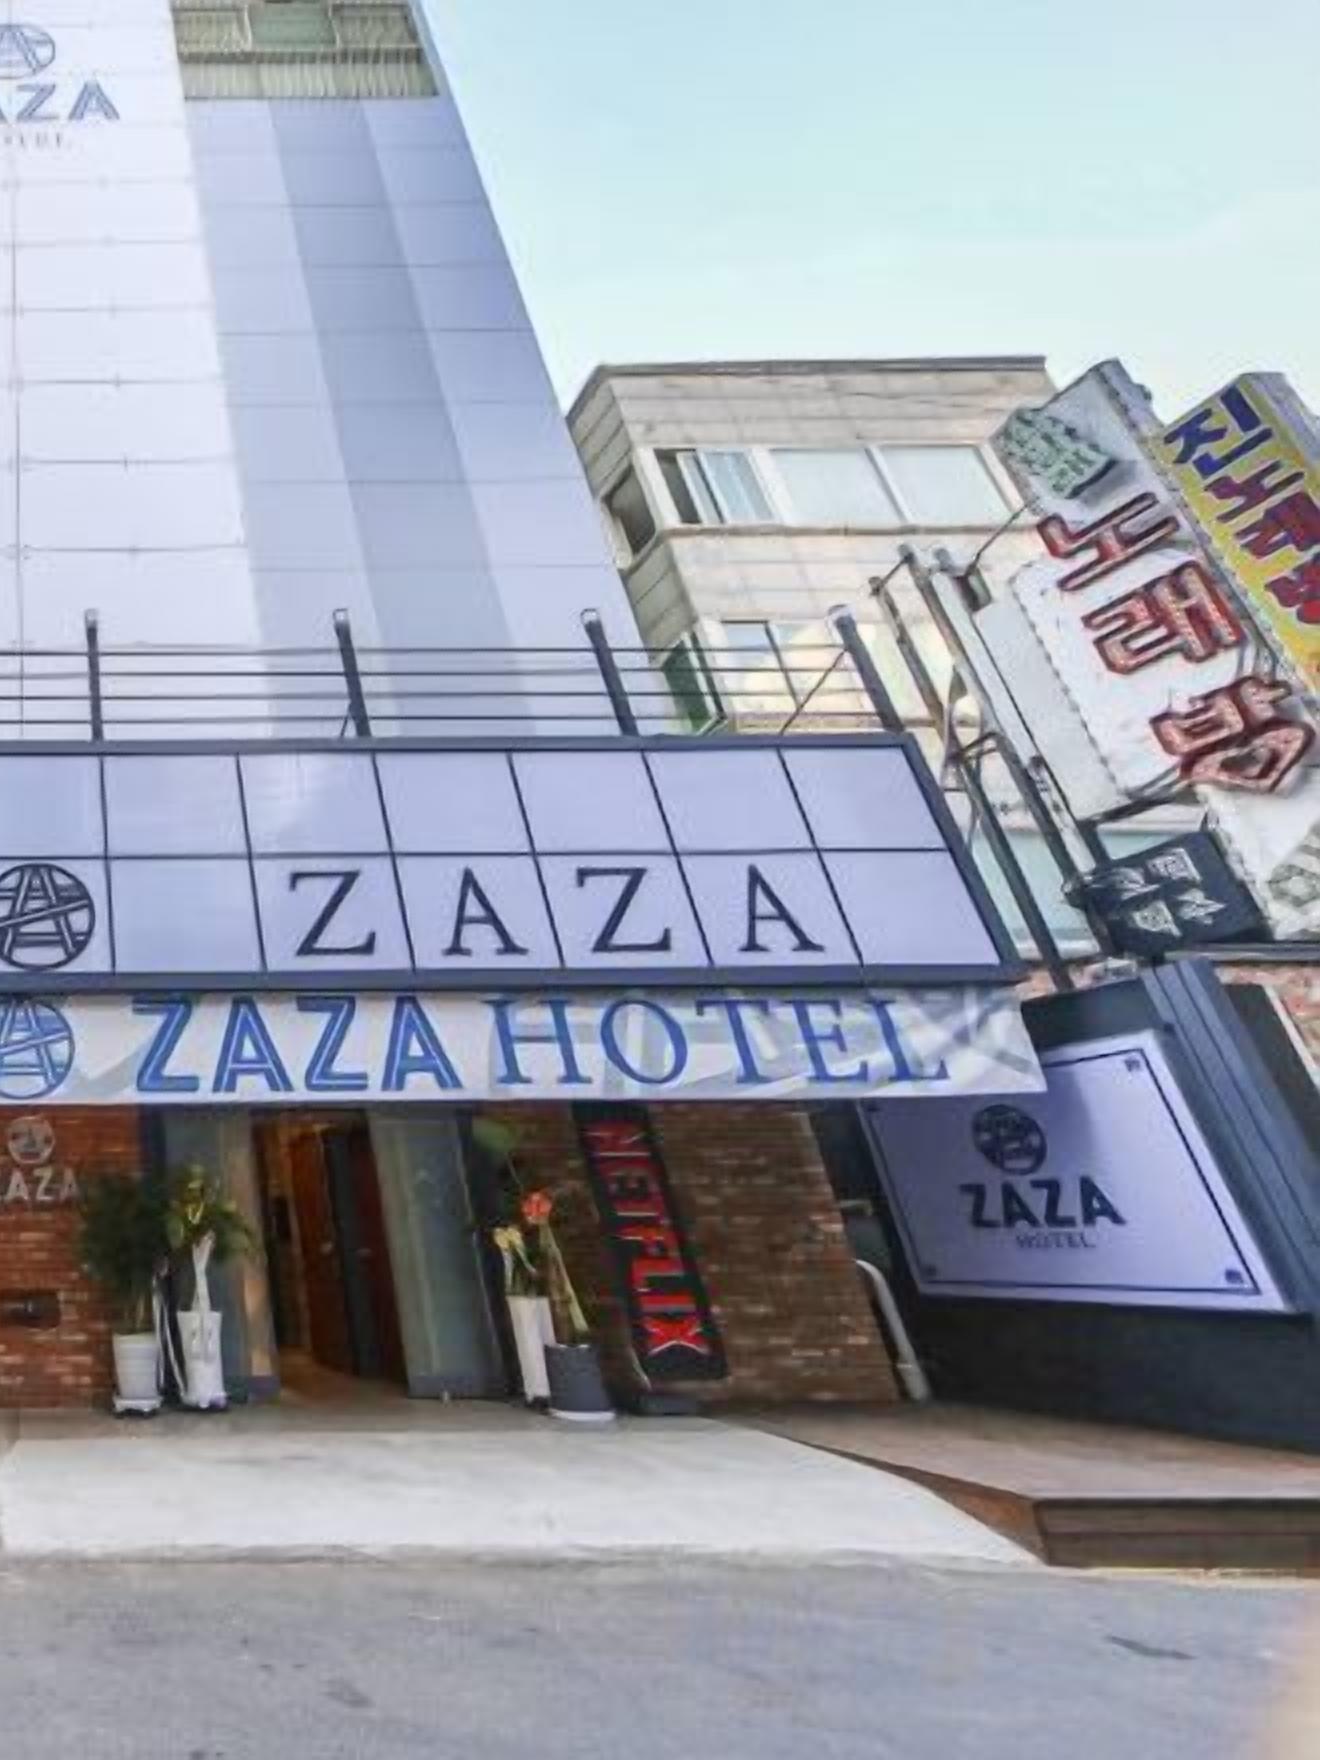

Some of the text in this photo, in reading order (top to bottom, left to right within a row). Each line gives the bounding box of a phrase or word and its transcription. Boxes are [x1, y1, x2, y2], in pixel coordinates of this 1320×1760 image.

[1036, 490, 1316, 795] 노래방
[288, 864, 825, 957] ZAZA
[132, 995, 466, 1093] ZAZA
[489, 998, 950, 1086] HOTEL
[582, 1121, 711, 1355] NETFLIX
[959, 1176, 1127, 1229] ZAZA
